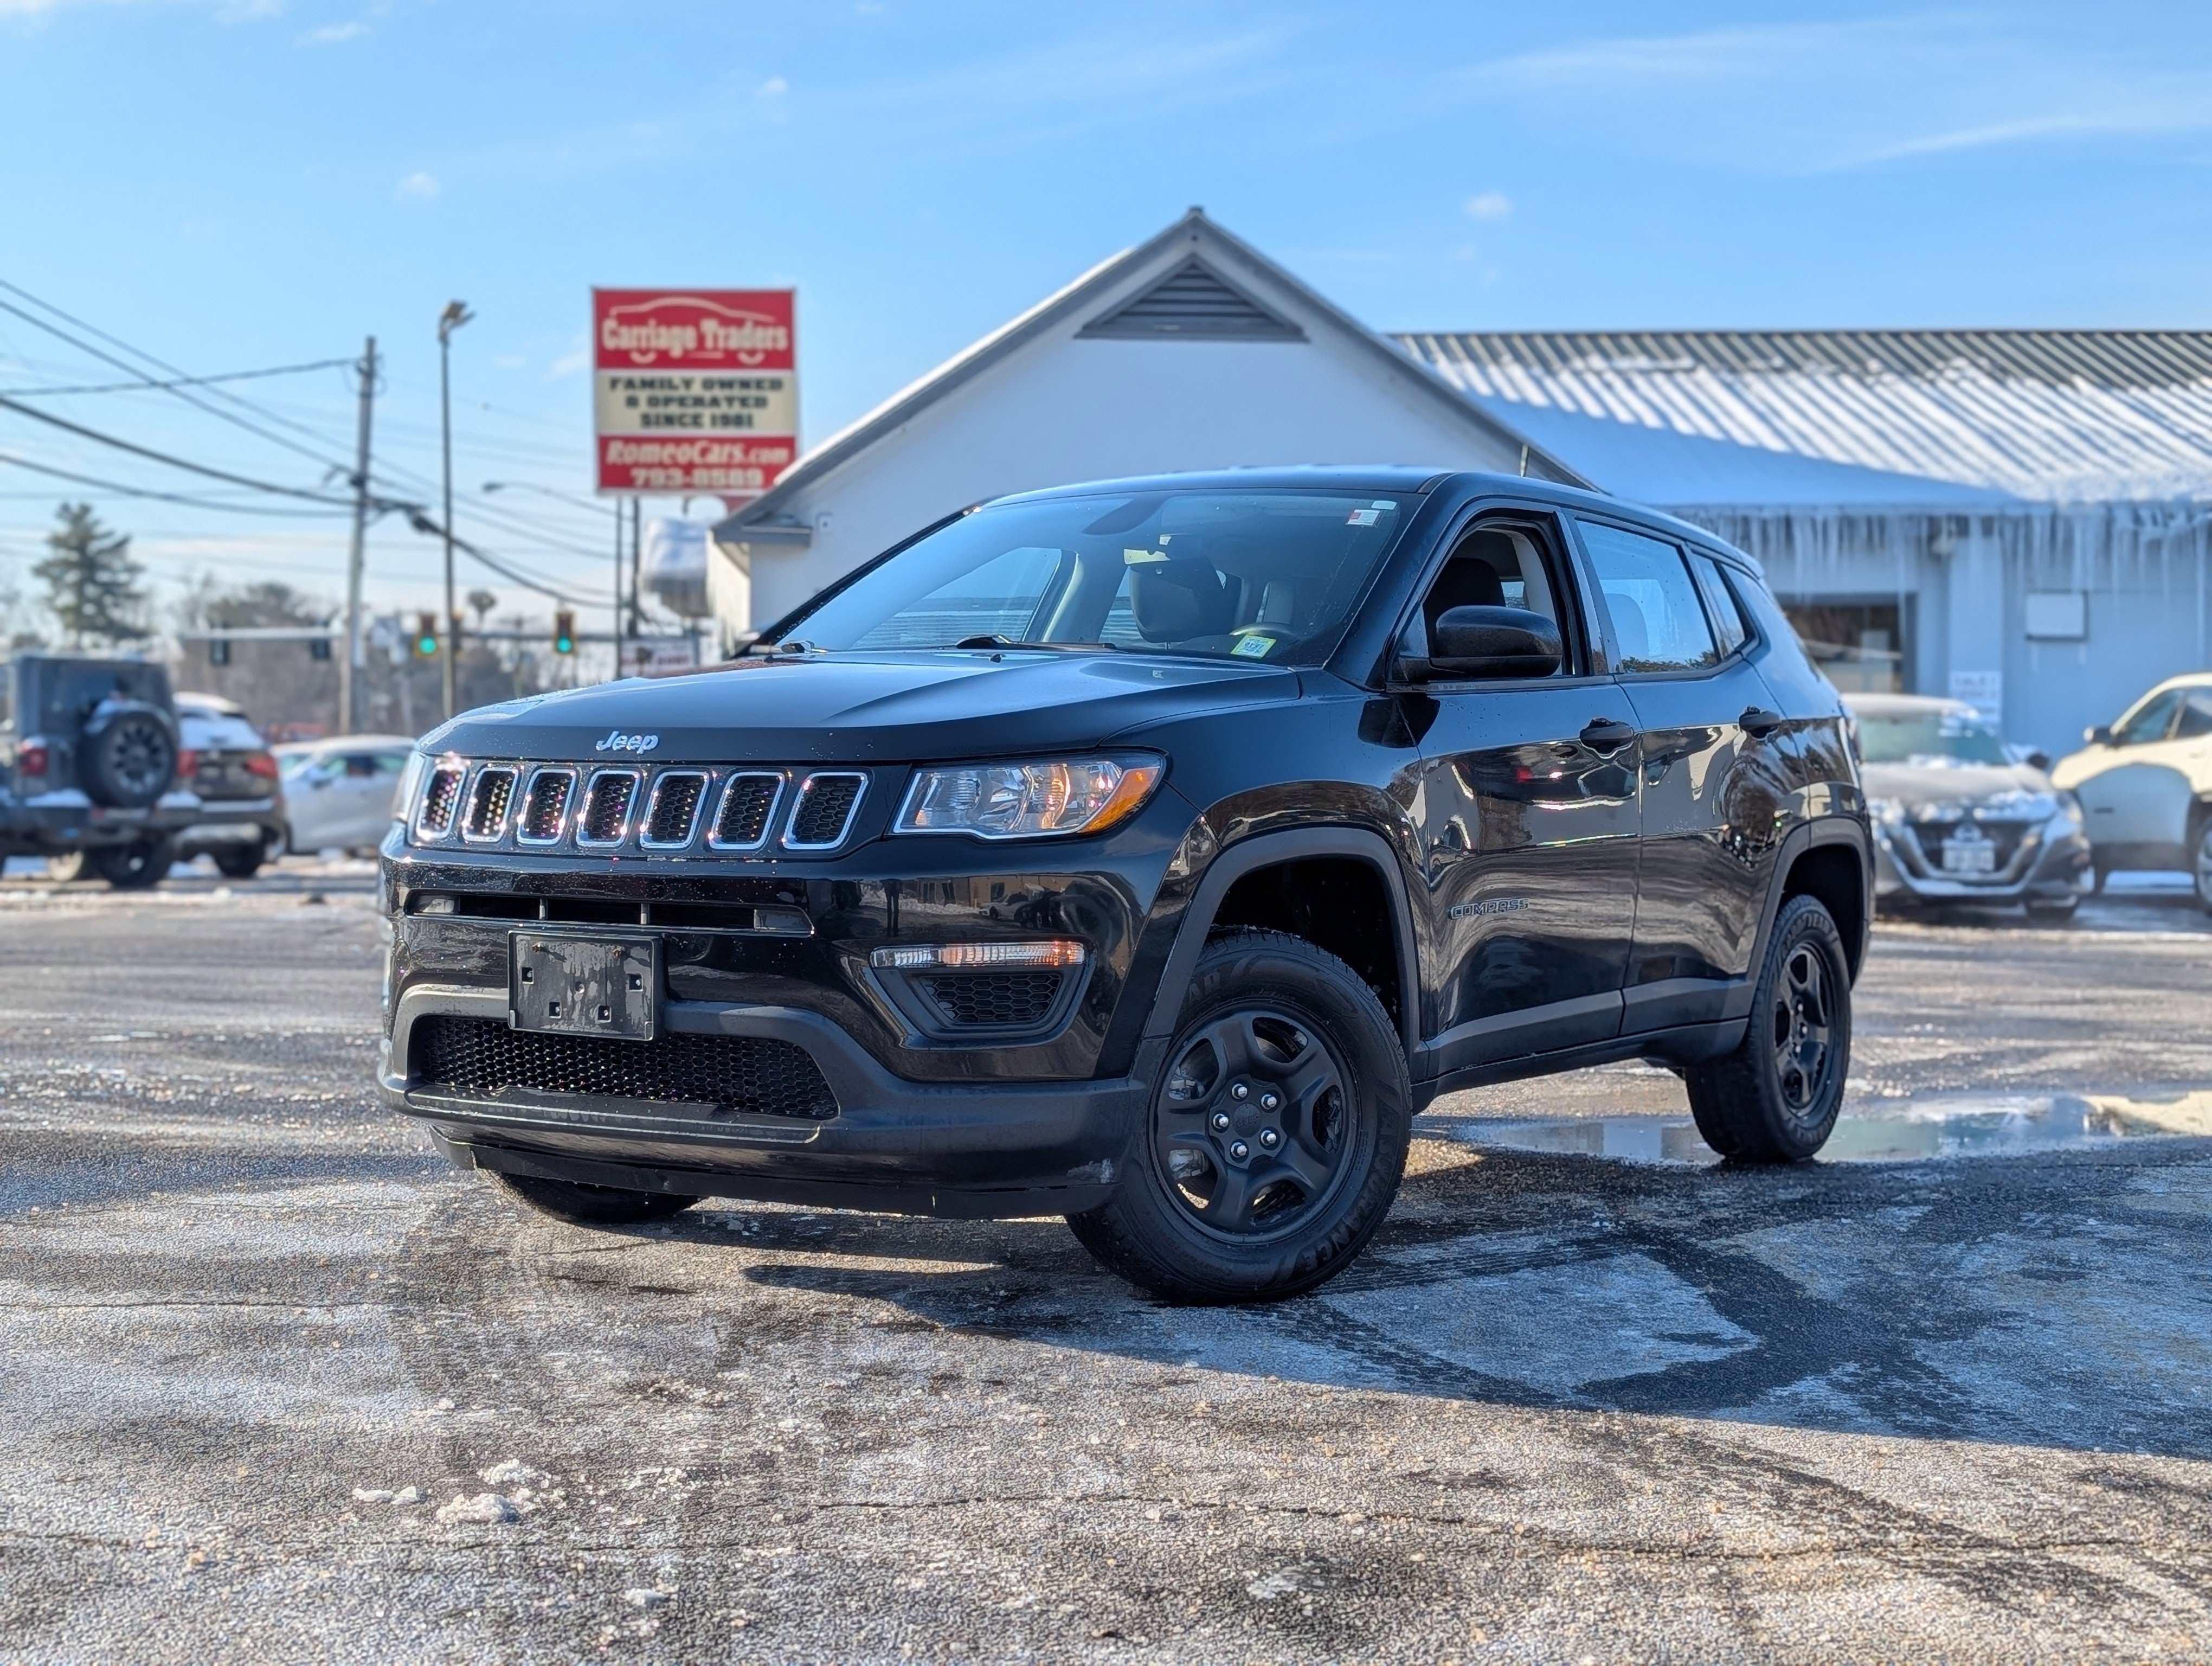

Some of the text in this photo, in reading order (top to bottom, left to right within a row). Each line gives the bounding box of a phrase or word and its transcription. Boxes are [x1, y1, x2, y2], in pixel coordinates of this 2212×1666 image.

[609, 377, 783, 391] FAMILY OWNED
[626, 395, 768, 409] & OPERATED
[640, 414, 704, 428] SINCE
[607, 440, 789, 465] RomeoCars.com
[595, 731, 659, 754] Jeep
[1451, 898, 1529, 919] COMPASS
